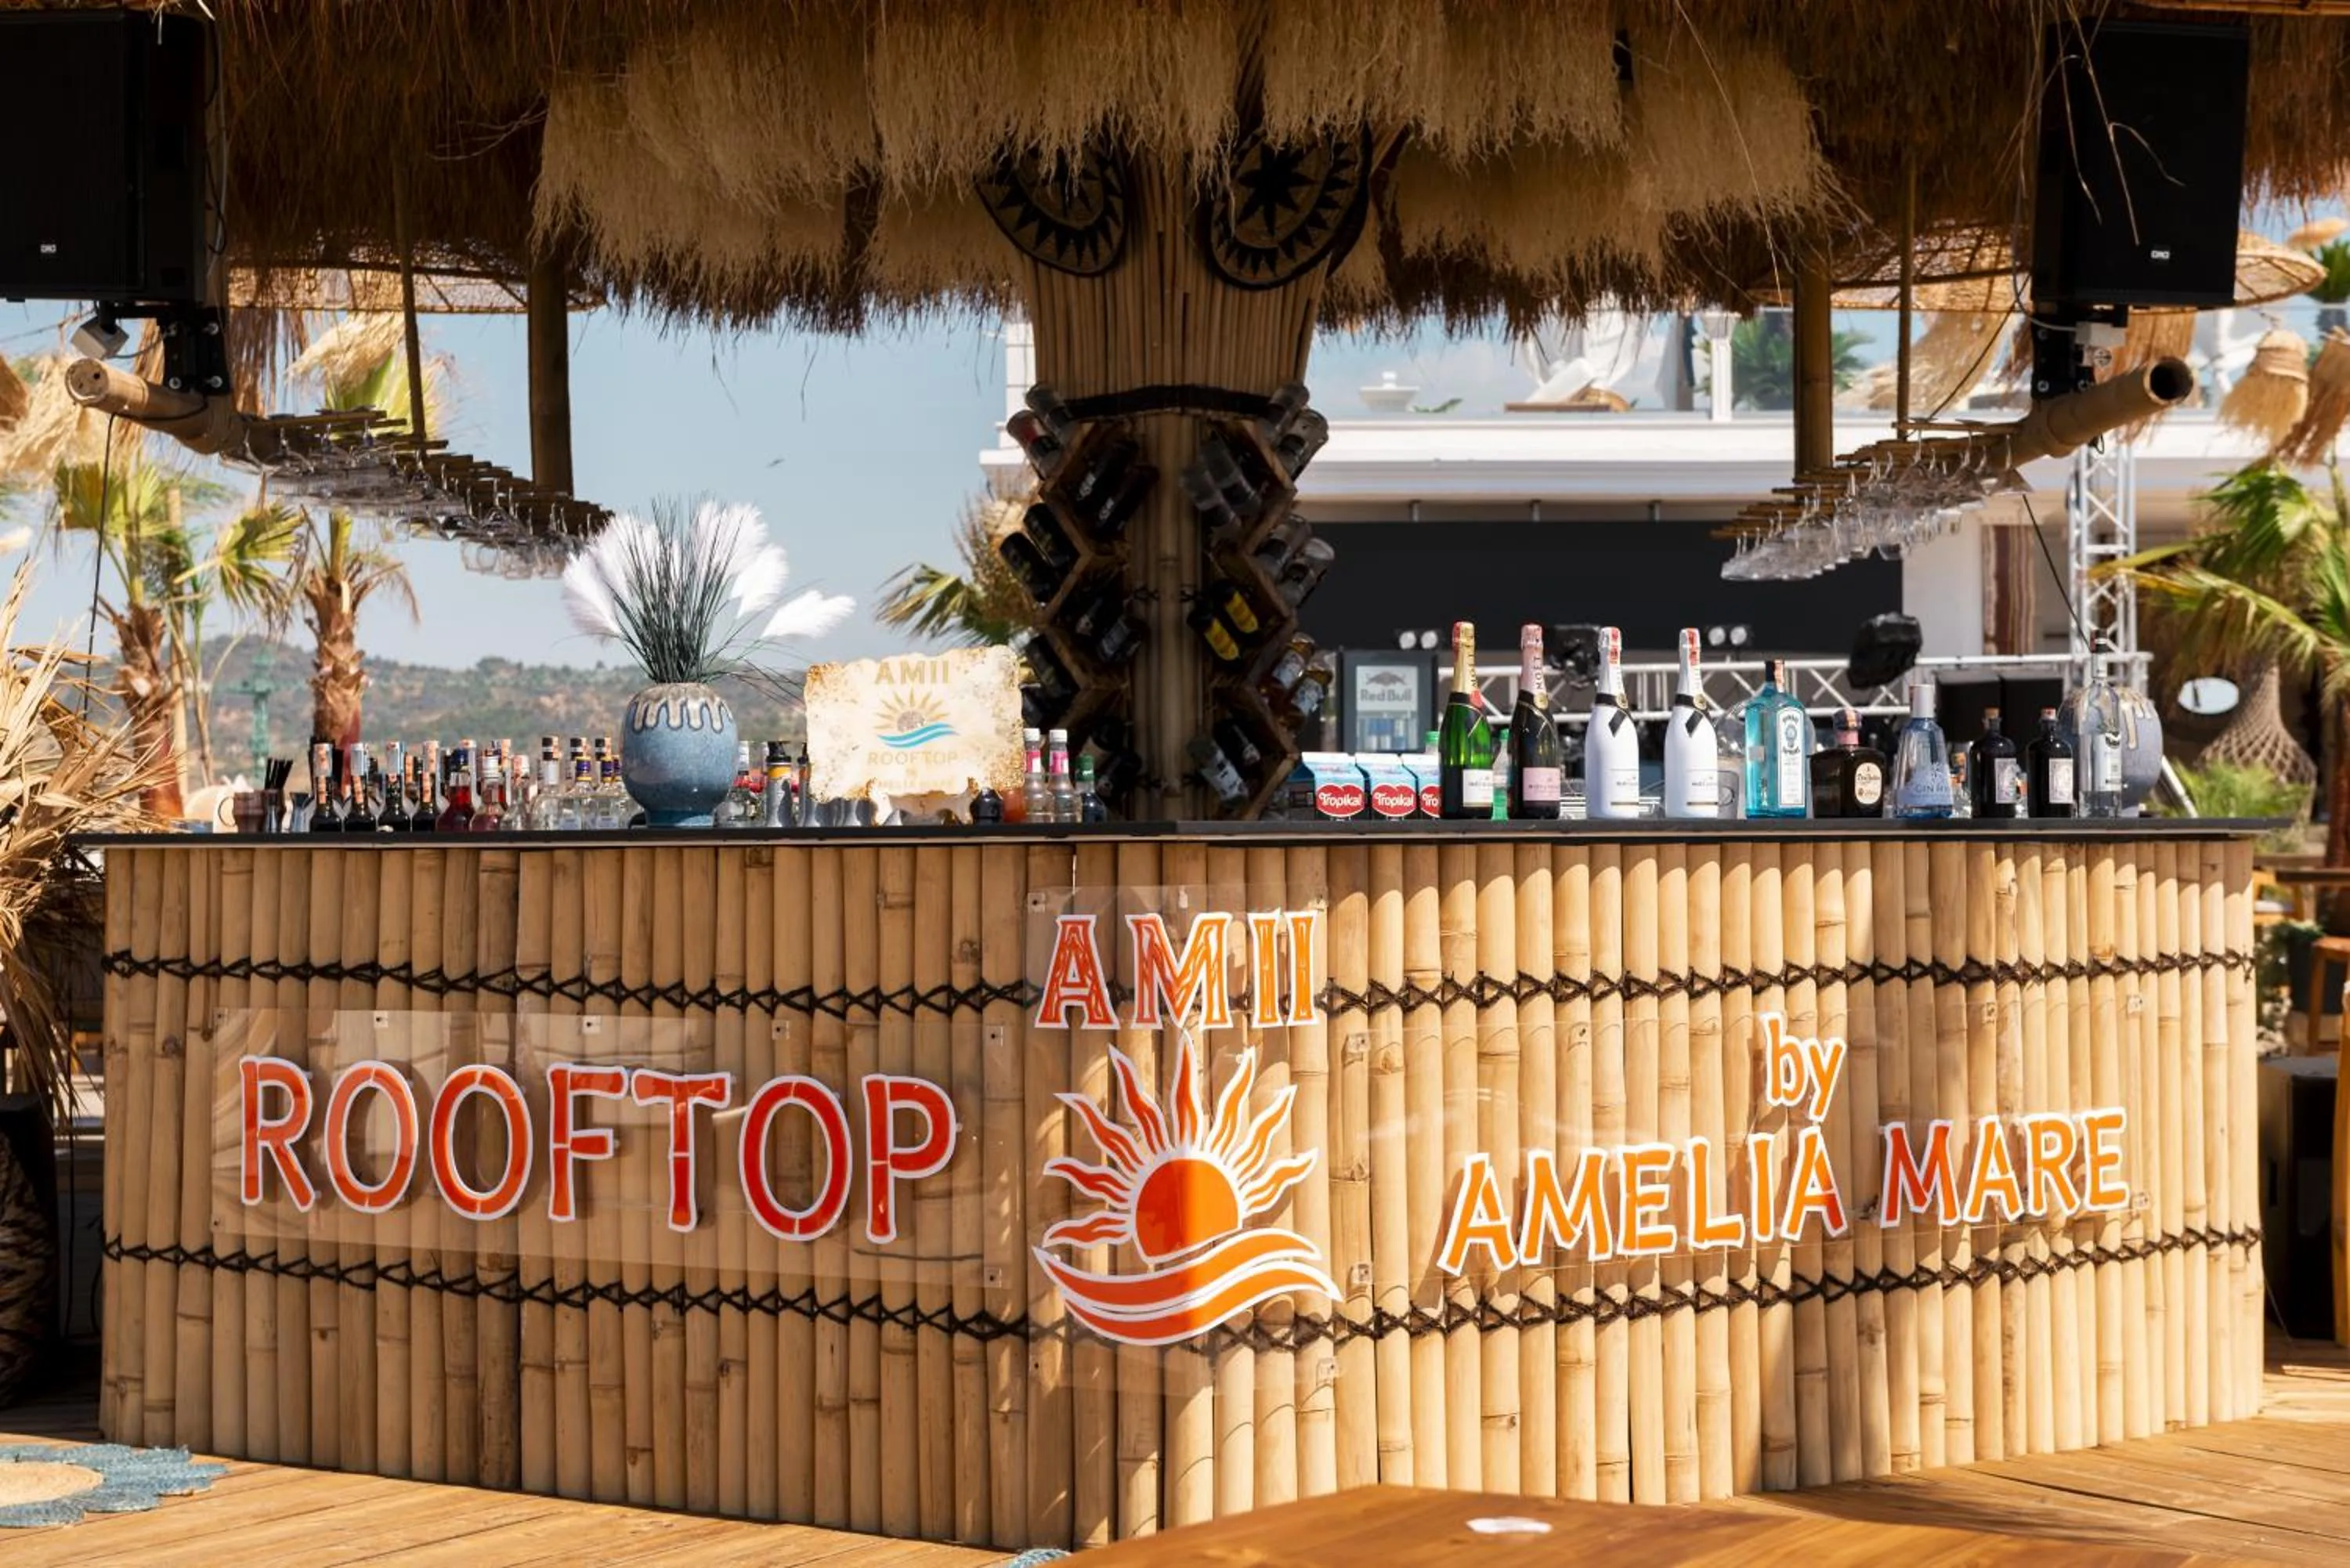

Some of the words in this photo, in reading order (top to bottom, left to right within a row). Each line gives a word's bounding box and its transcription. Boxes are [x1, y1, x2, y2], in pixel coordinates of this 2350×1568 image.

[874, 659, 949, 685] AMII
[1360, 688, 1385, 702] Red
[1387, 688, 1412, 702] Bull
[867, 751, 958, 765] ROOFTOP
[1318, 792, 1362, 808] Tropikal
[1374, 792, 1414, 807] Tropikal
[1034, 908, 1319, 1031] AMII
[1759, 1011, 1846, 1122] by
[240, 1055, 956, 1244] ROOFTOP
[1437, 1125, 1849, 1277] AMELIA
[1880, 1106, 2130, 1229] MARE
